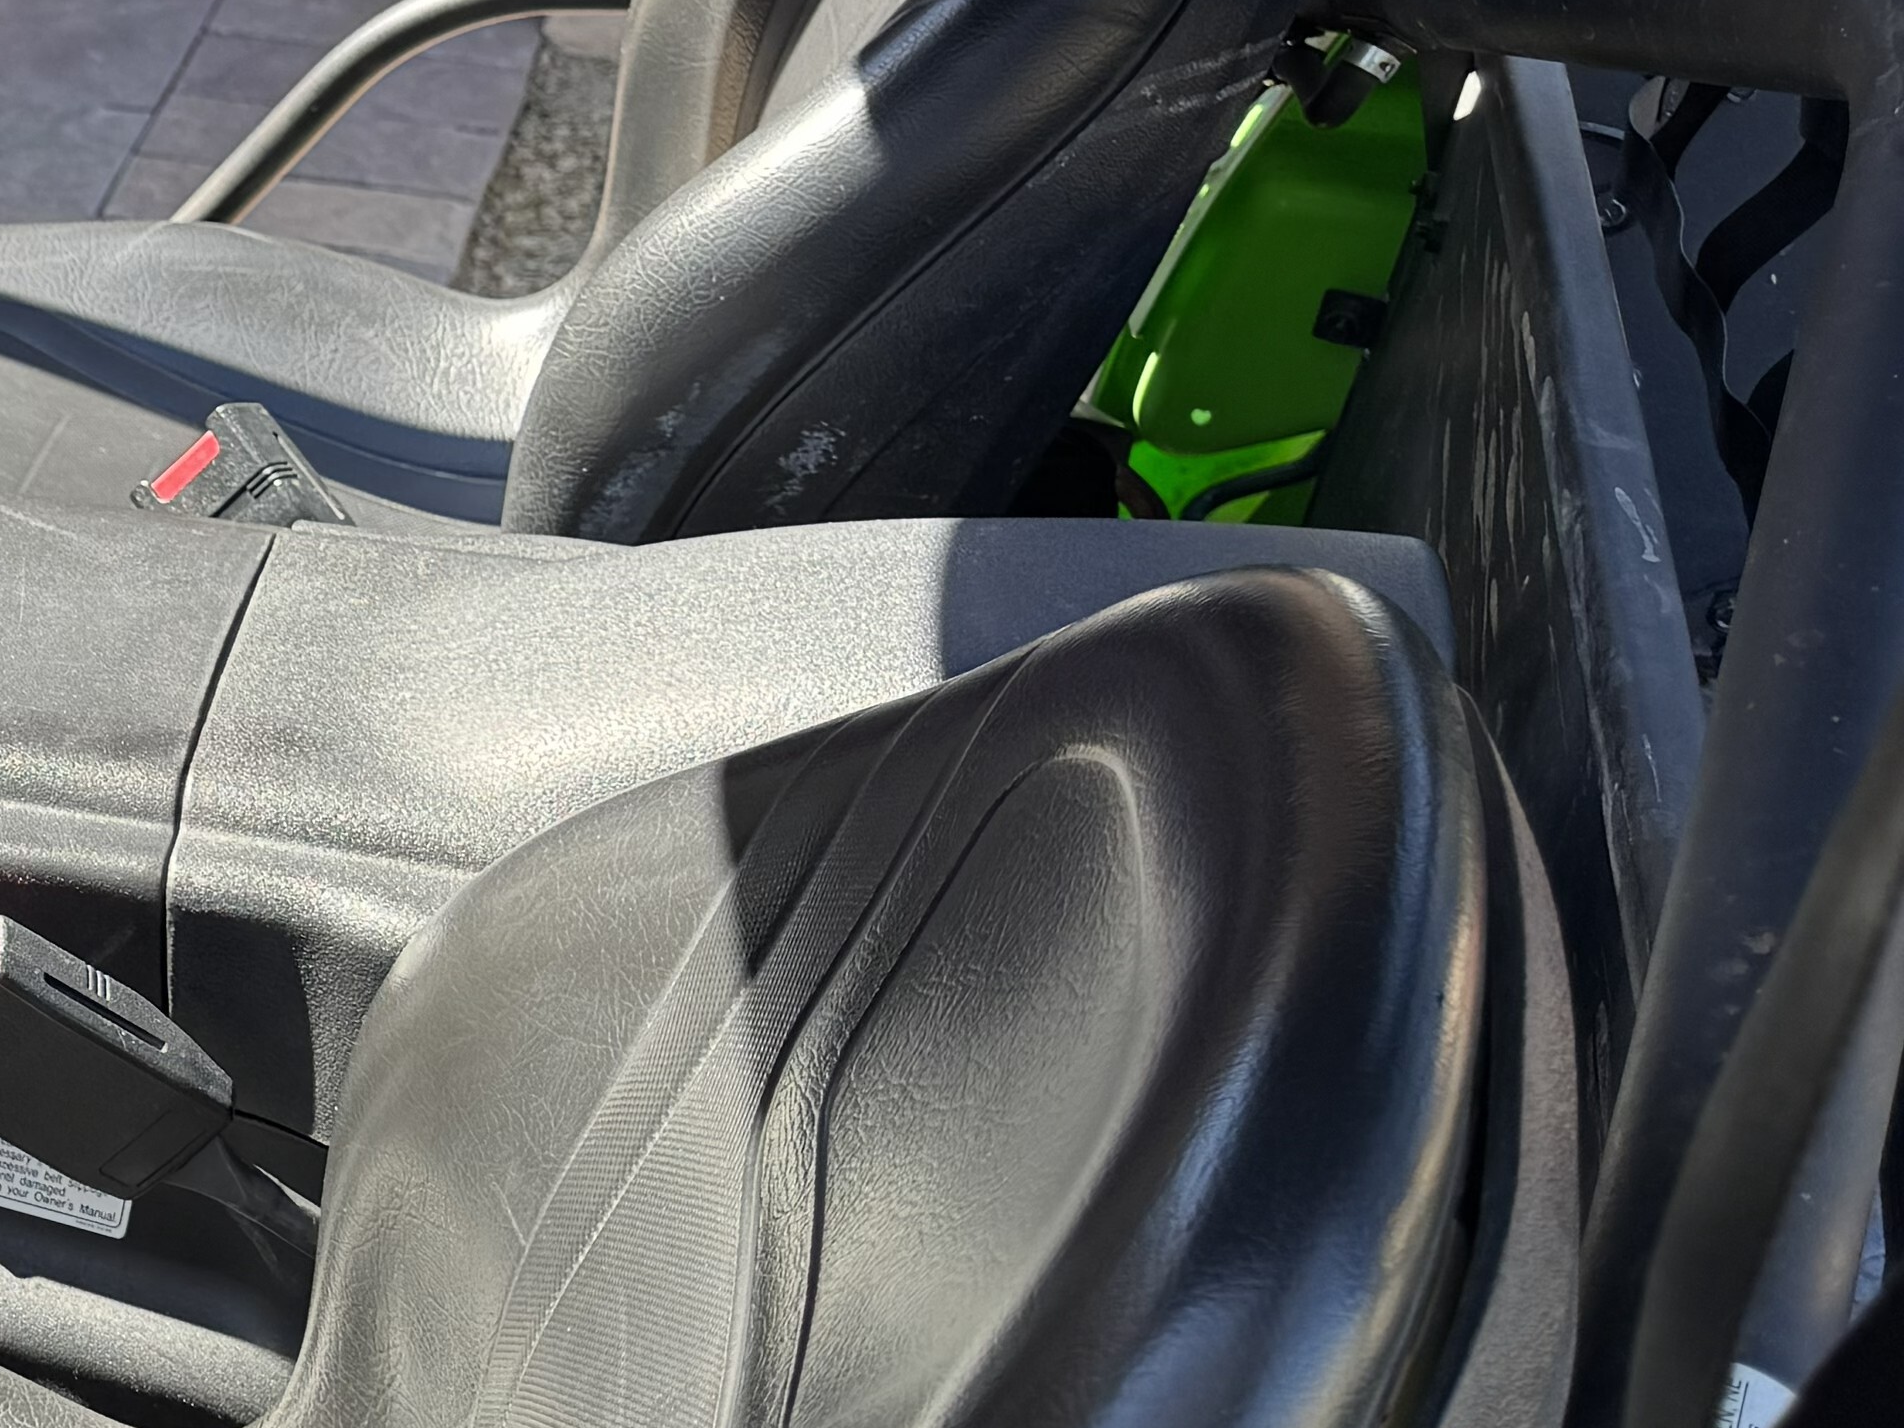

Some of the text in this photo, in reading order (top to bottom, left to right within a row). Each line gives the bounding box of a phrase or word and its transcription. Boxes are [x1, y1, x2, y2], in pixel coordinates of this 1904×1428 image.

[19, 1176, 66, 1197] damaged
[44, 1171, 63, 1185] belt
[7, 1186, 29, 1199] your
[33, 1191, 74, 1211] Owner's
